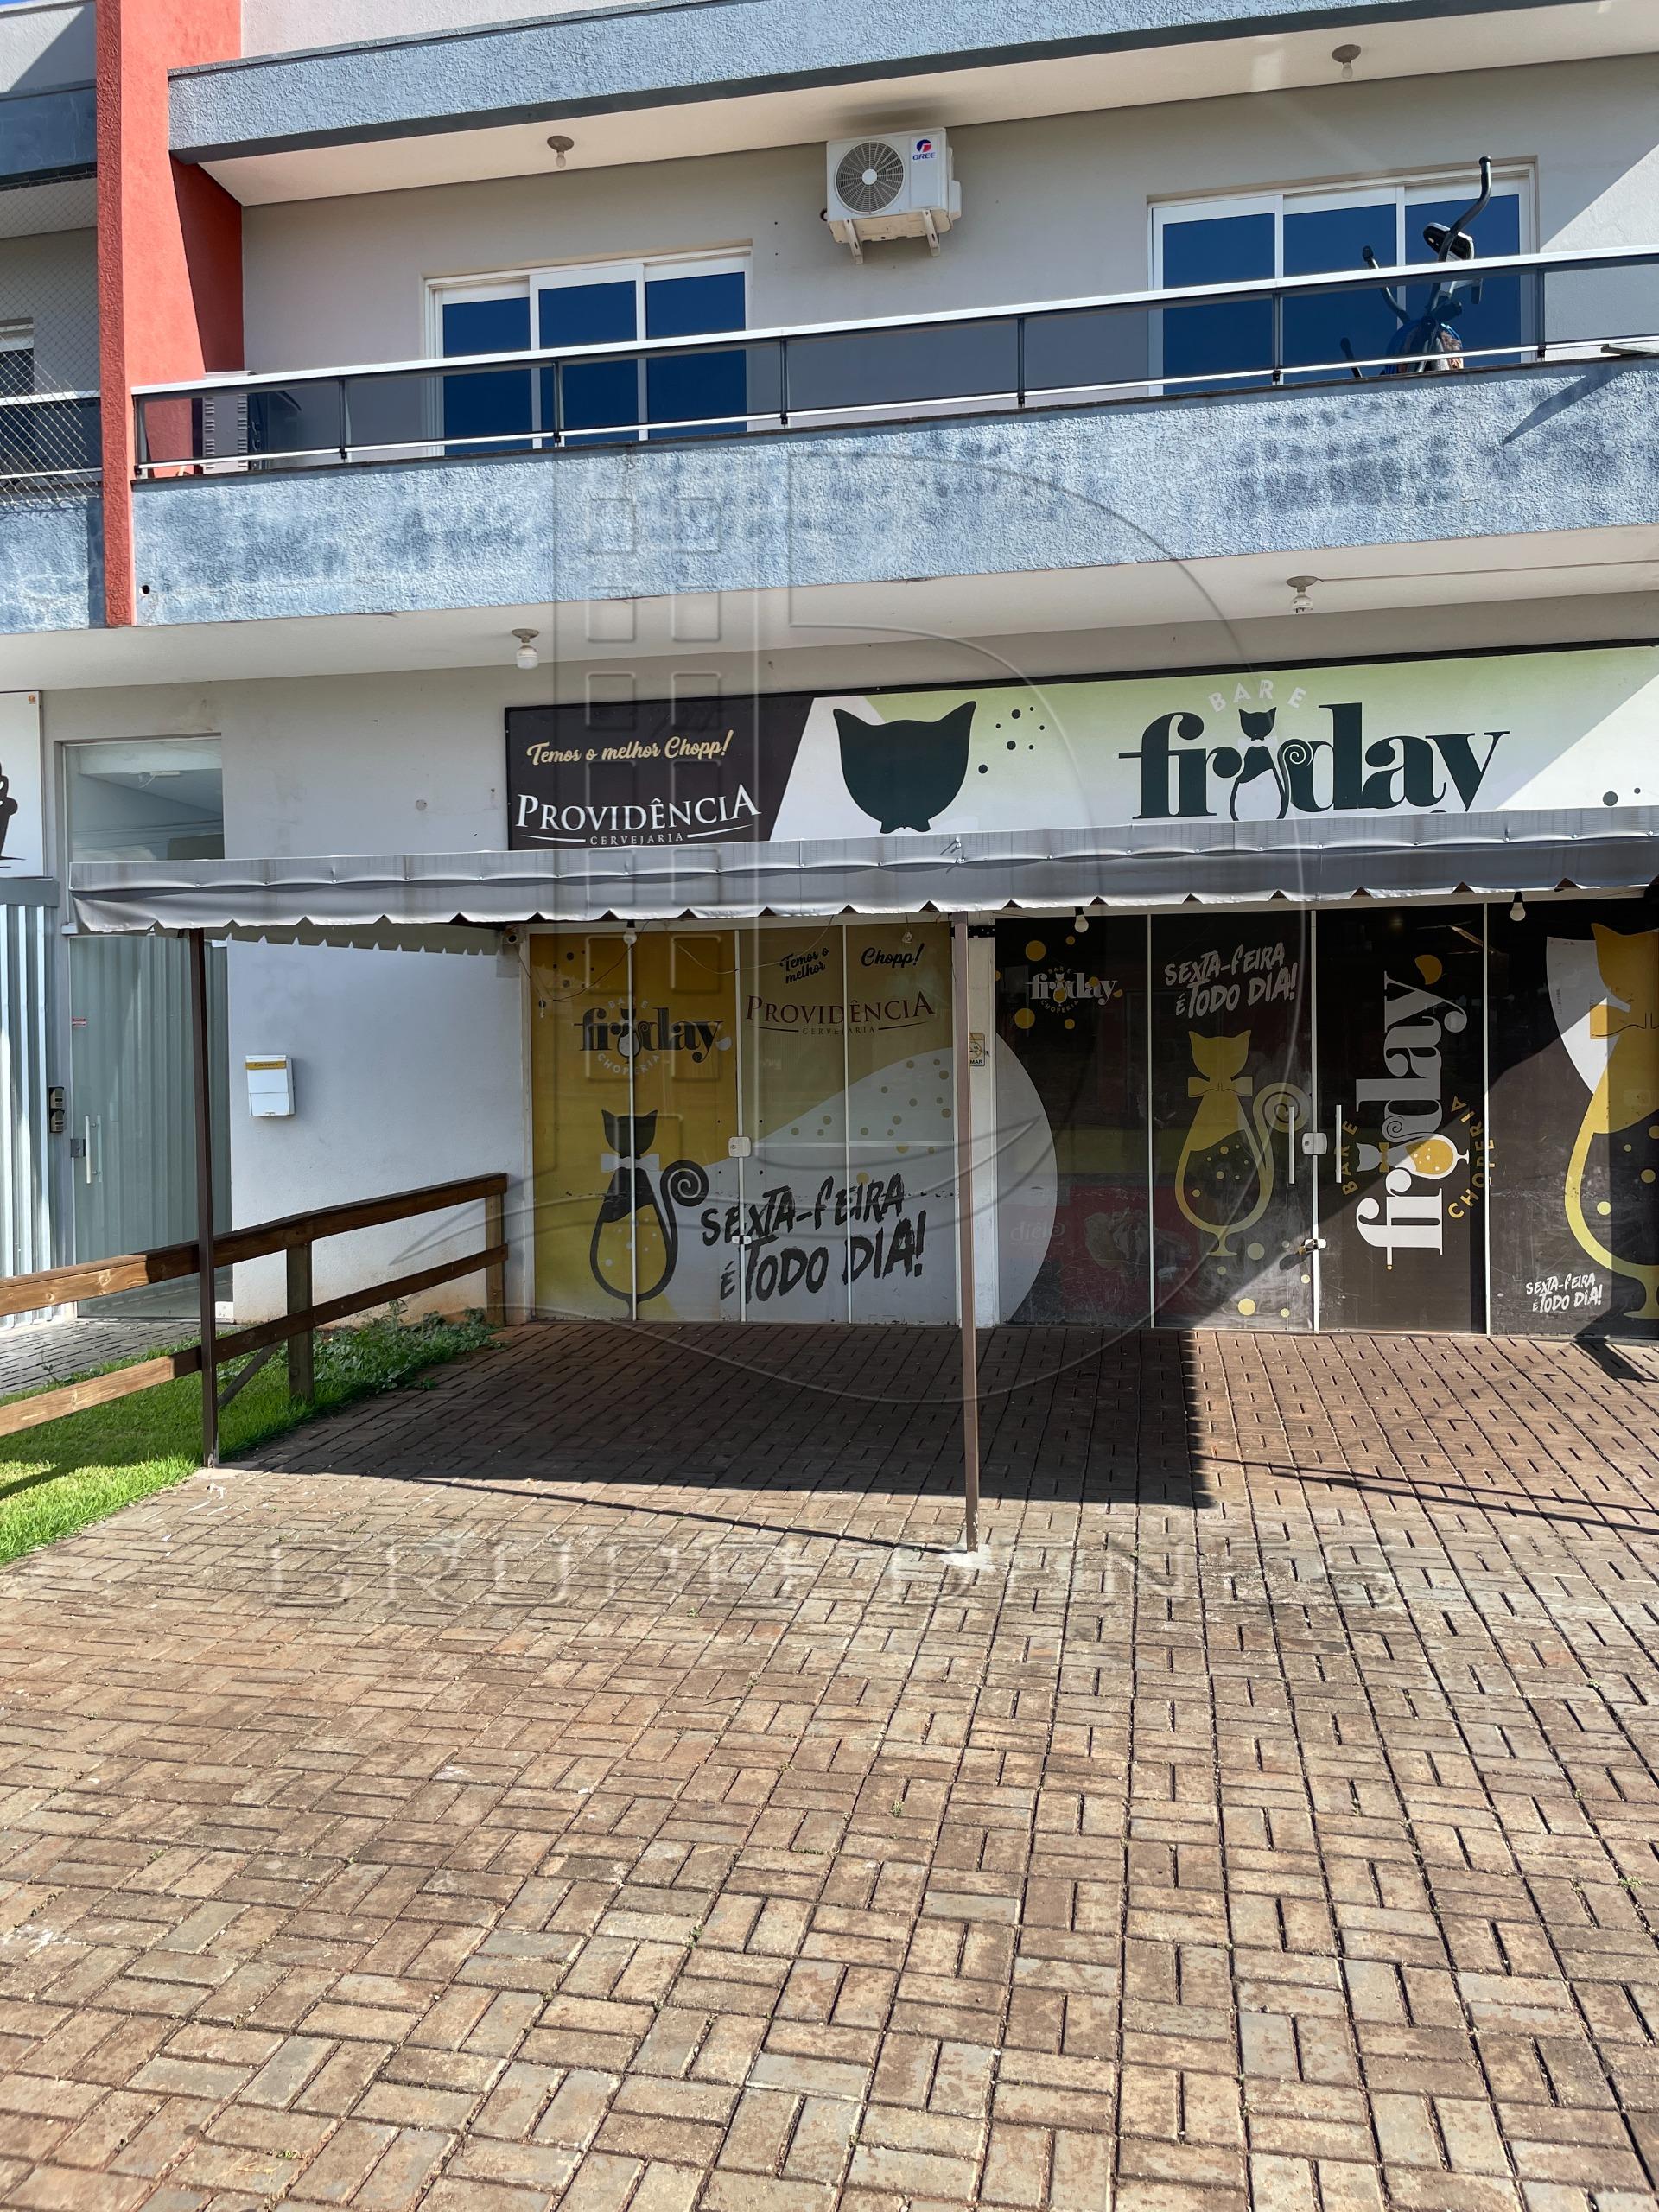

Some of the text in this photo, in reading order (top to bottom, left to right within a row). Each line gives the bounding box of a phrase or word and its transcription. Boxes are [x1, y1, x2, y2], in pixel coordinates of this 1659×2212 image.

[912, 152, 937, 161] GREE
[526, 729, 734, 766] Temos o melhor Chopp!
[515, 784, 762, 831] PROVIDÊNCIA
[589, 832, 683, 846] CERVEJARIA
[780, 947, 830, 971] Temos o
[861, 943, 925, 968] Chopp!
[1164, 941, 1286, 987] SEXTA-FEIRA
[785, 961, 826, 984] melhor
[1025, 972, 1119, 1006] friday
[746, 991, 936, 1024] PROVIDÊNCIA
[1040, 999, 1080, 1014] CHOPERIA
[1187, 978, 1241, 1019] TODO
[1247, 963, 1299, 1007] DIA!
[574, 1007, 724, 1063] friday
[1356, 971, 1467, 1268] friday
[701, 1173, 905, 1246] SEXTA-FEIRA
[739, 1234, 830, 1305] TODO
[842, 1210, 927, 1286] DIA!
[1526, 1272, 1596, 1295] SEXTA-FEIRA
[1538, 1291, 1570, 1313] TODO
[1573, 1284, 1604, 1307] DIA!
